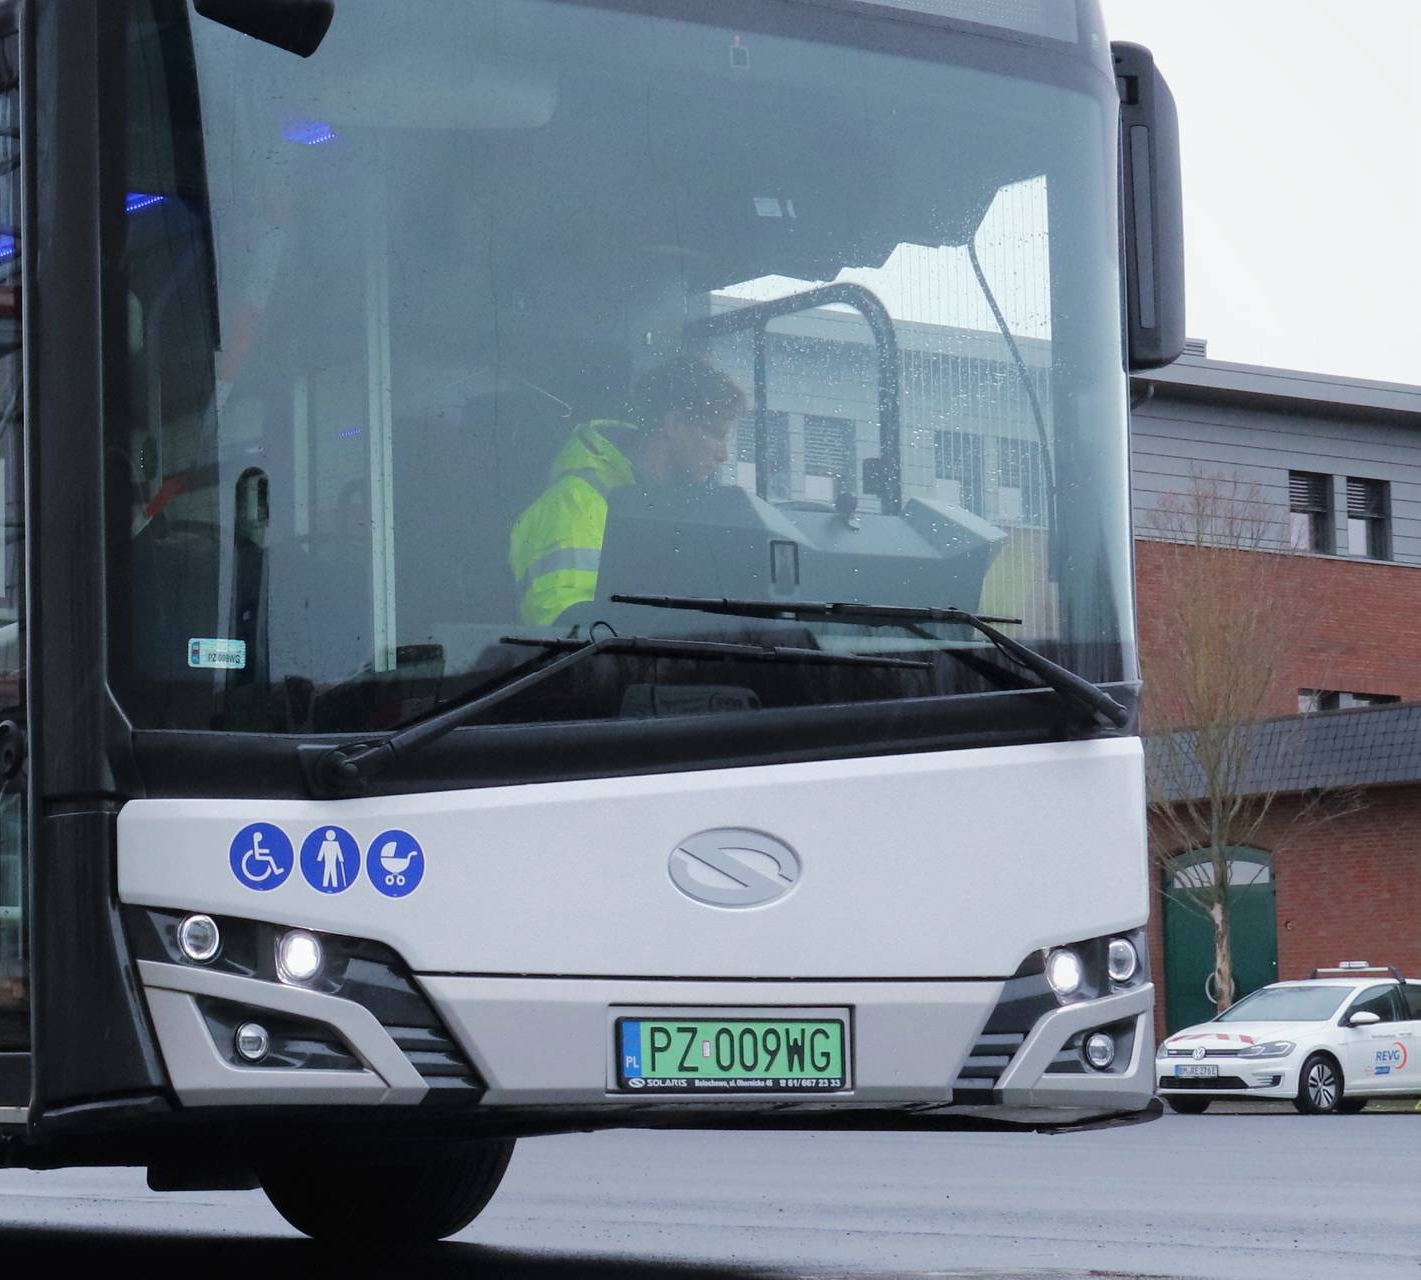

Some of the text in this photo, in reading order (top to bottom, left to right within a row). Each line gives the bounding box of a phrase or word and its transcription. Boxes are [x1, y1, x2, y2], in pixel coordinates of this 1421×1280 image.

[650, 1027, 831, 1072] PZ 009WG
[1375, 1050, 1401, 1061] REVG
[625, 1056, 640, 1069] PL
[647, 1079, 688, 1087] SOLARIS
[818, 1079, 829, 1087] 23
